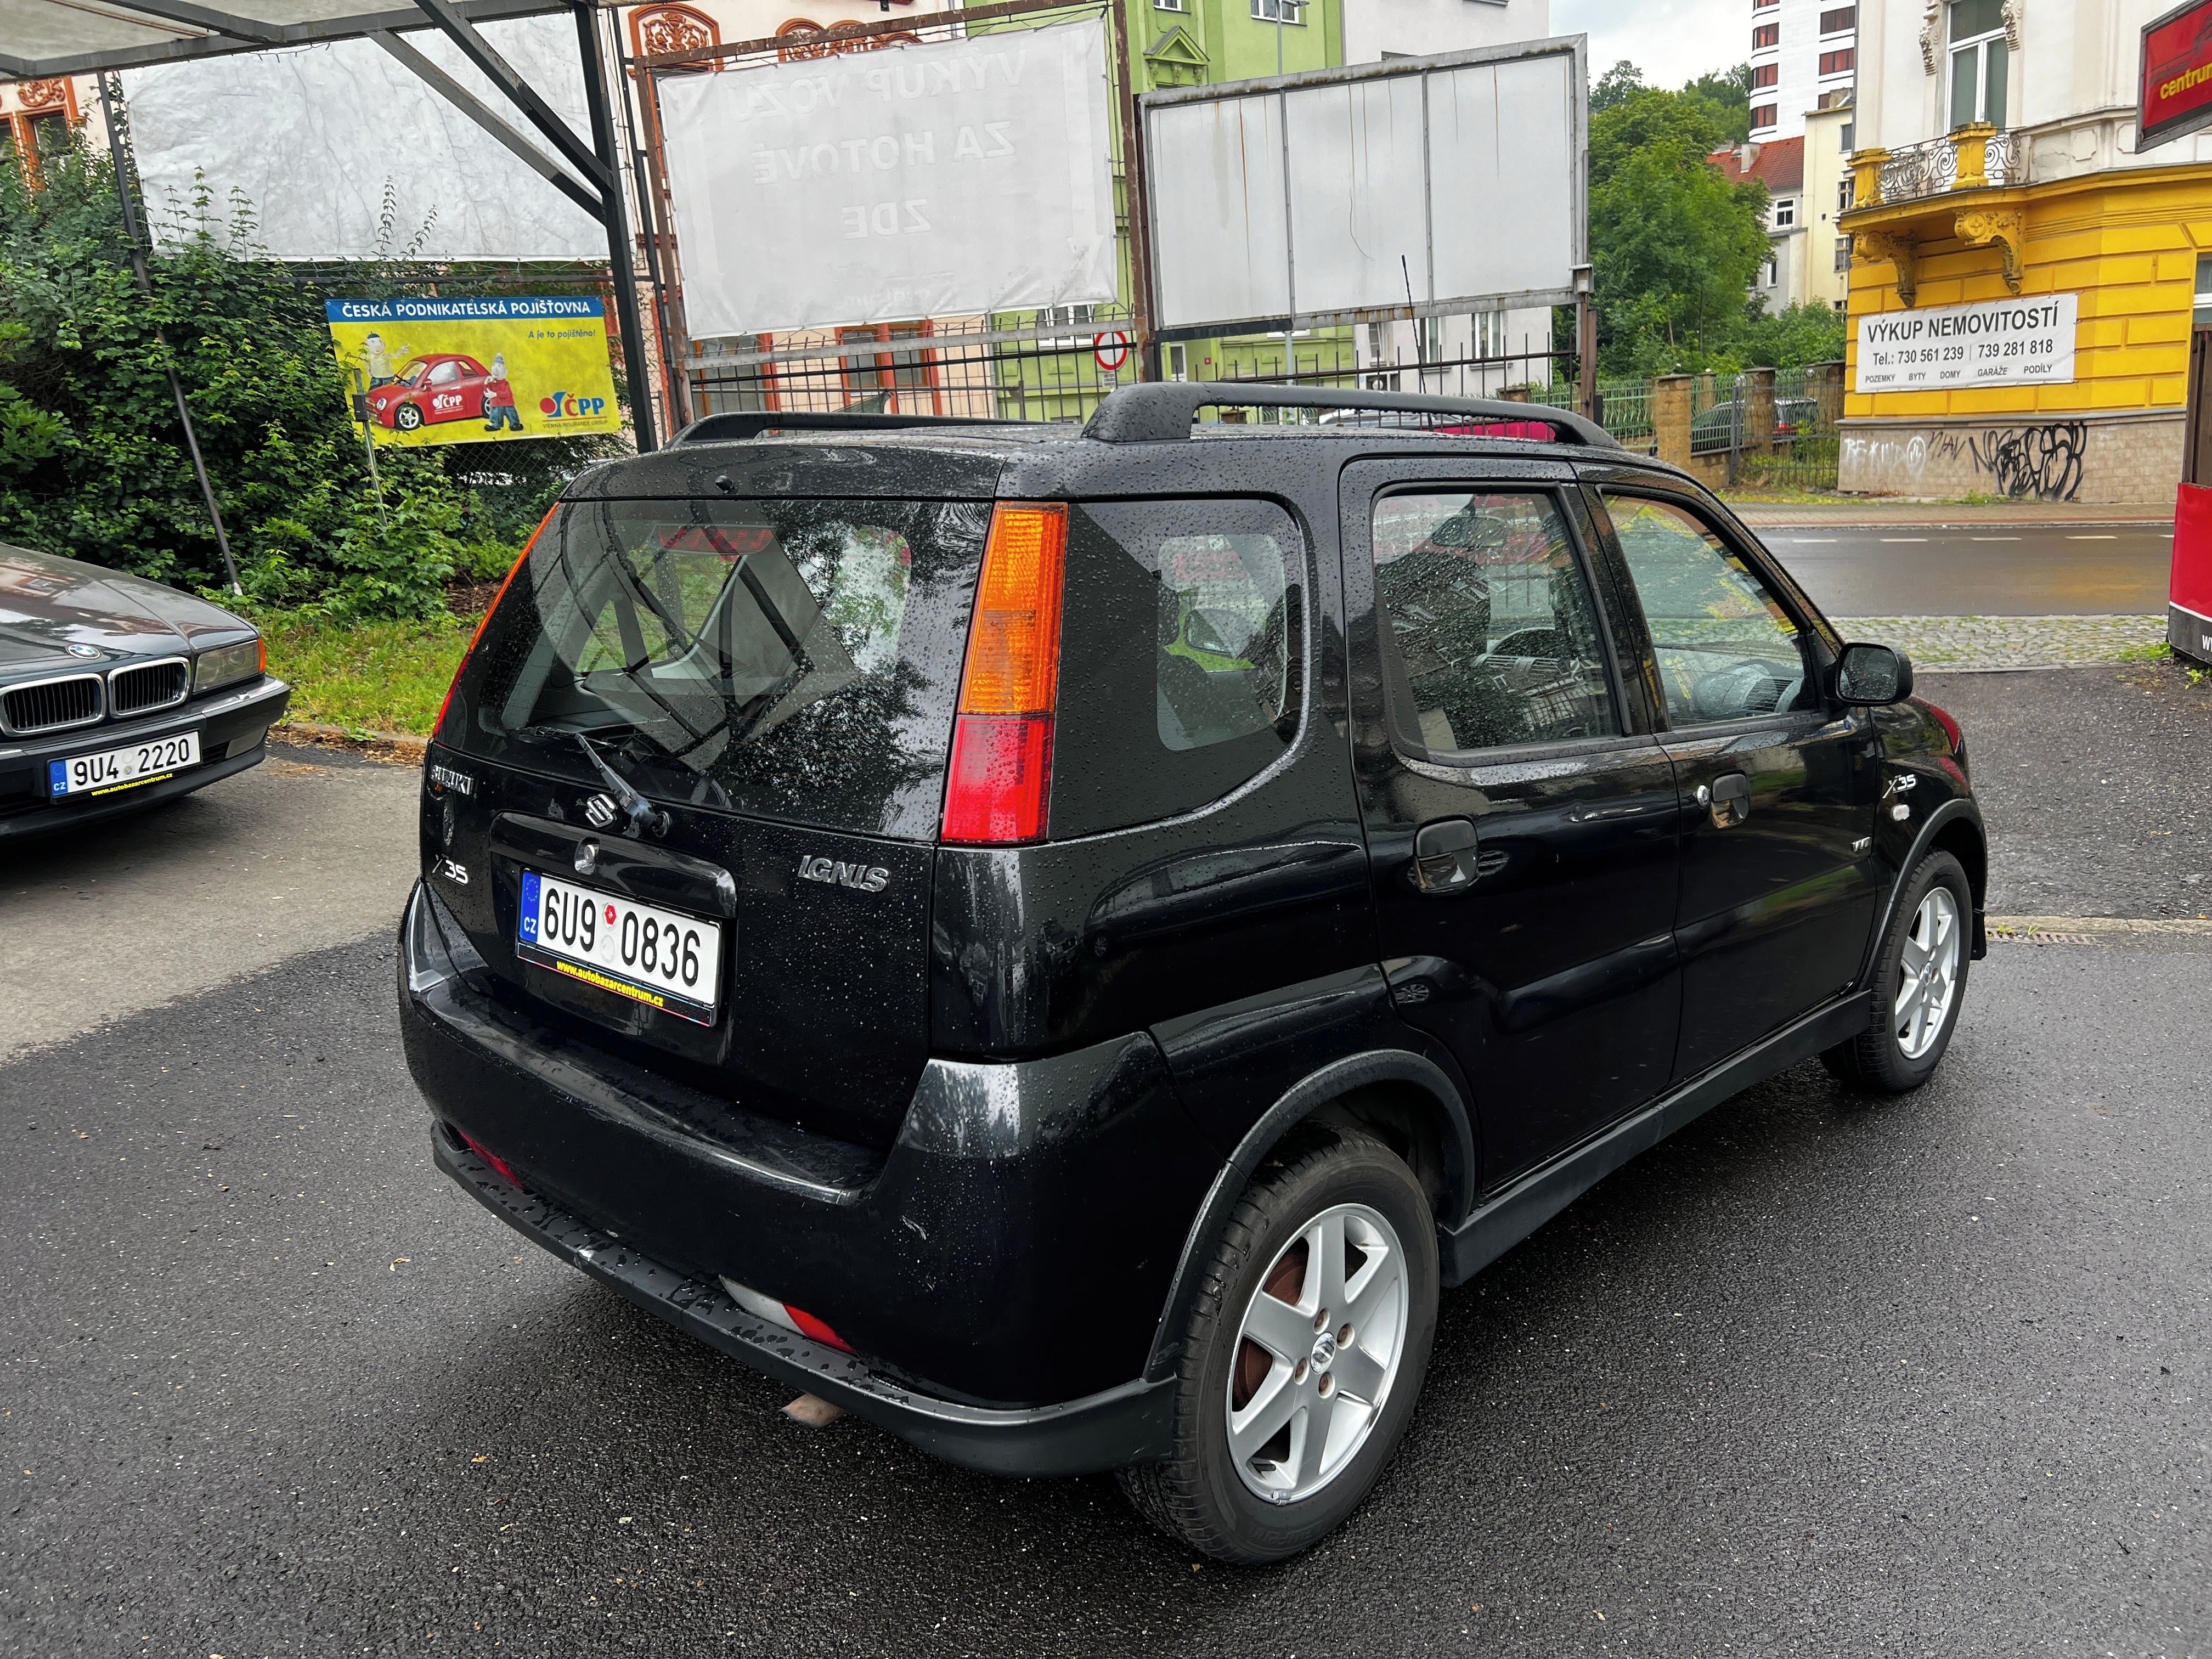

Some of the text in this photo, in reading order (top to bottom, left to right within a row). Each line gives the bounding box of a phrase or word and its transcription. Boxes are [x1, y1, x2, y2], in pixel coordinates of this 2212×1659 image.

[342, 300, 591, 317] ČESKÁ PODNIKATELSKÁ POJIŠŤOVNA
[537, 330, 544, 340] je
[557, 329, 596, 340] pojištěno!
[1867, 301, 2059, 343] VÝKUP NEMOVITOSTÍ
[1874, 338, 2053, 365] Tel.: 730 561 239 739 281 818
[1865, 364, 2052, 383] POZEMKY BYTY DOMY GARÁŽE PODÍLY
[565, 393, 605, 416] ČPP
[74, 738, 189, 786] 9U4 2220
[53, 782, 66, 792] CZ
[91, 772, 173, 797] www.autobazarcentrum.cz
[430, 764, 474, 795] SUZUKI
[797, 855, 891, 892] IGNIS
[524, 916, 537, 934] CZ
[544, 888, 701, 988] 6U9 0836
[557, 961, 664, 1007] www.autobazarcentrum.cz
